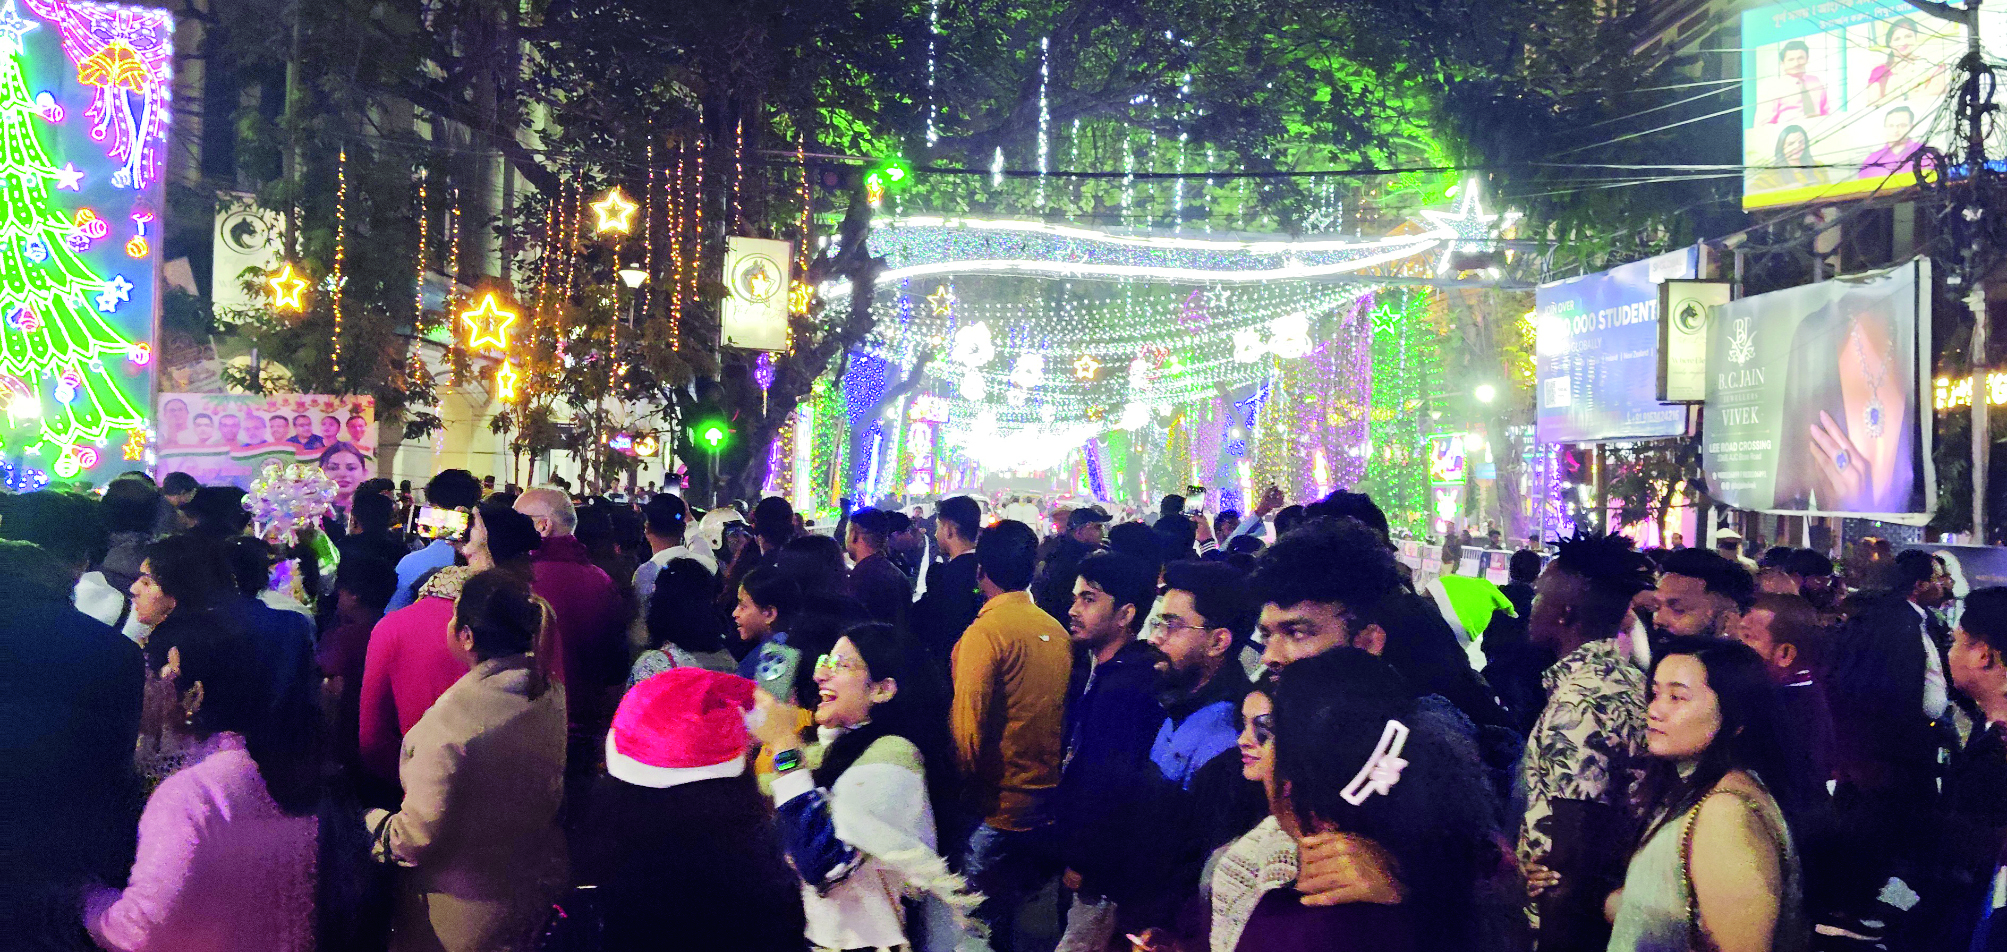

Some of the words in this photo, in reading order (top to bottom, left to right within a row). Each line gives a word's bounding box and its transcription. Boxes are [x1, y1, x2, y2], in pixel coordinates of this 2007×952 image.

[1545, 302, 1557, 316] JOIN
[1558, 300, 1574, 313] OVER
[1571, 337, 1603, 353] GLOBALLY
[1739, 366, 1765, 388] JAIN
[1722, 405, 1759, 426] VIVEK
[1709, 442, 1720, 454] LEE
[1720, 441, 1738, 453] ROAD
[1738, 439, 1772, 452] CROSSING
